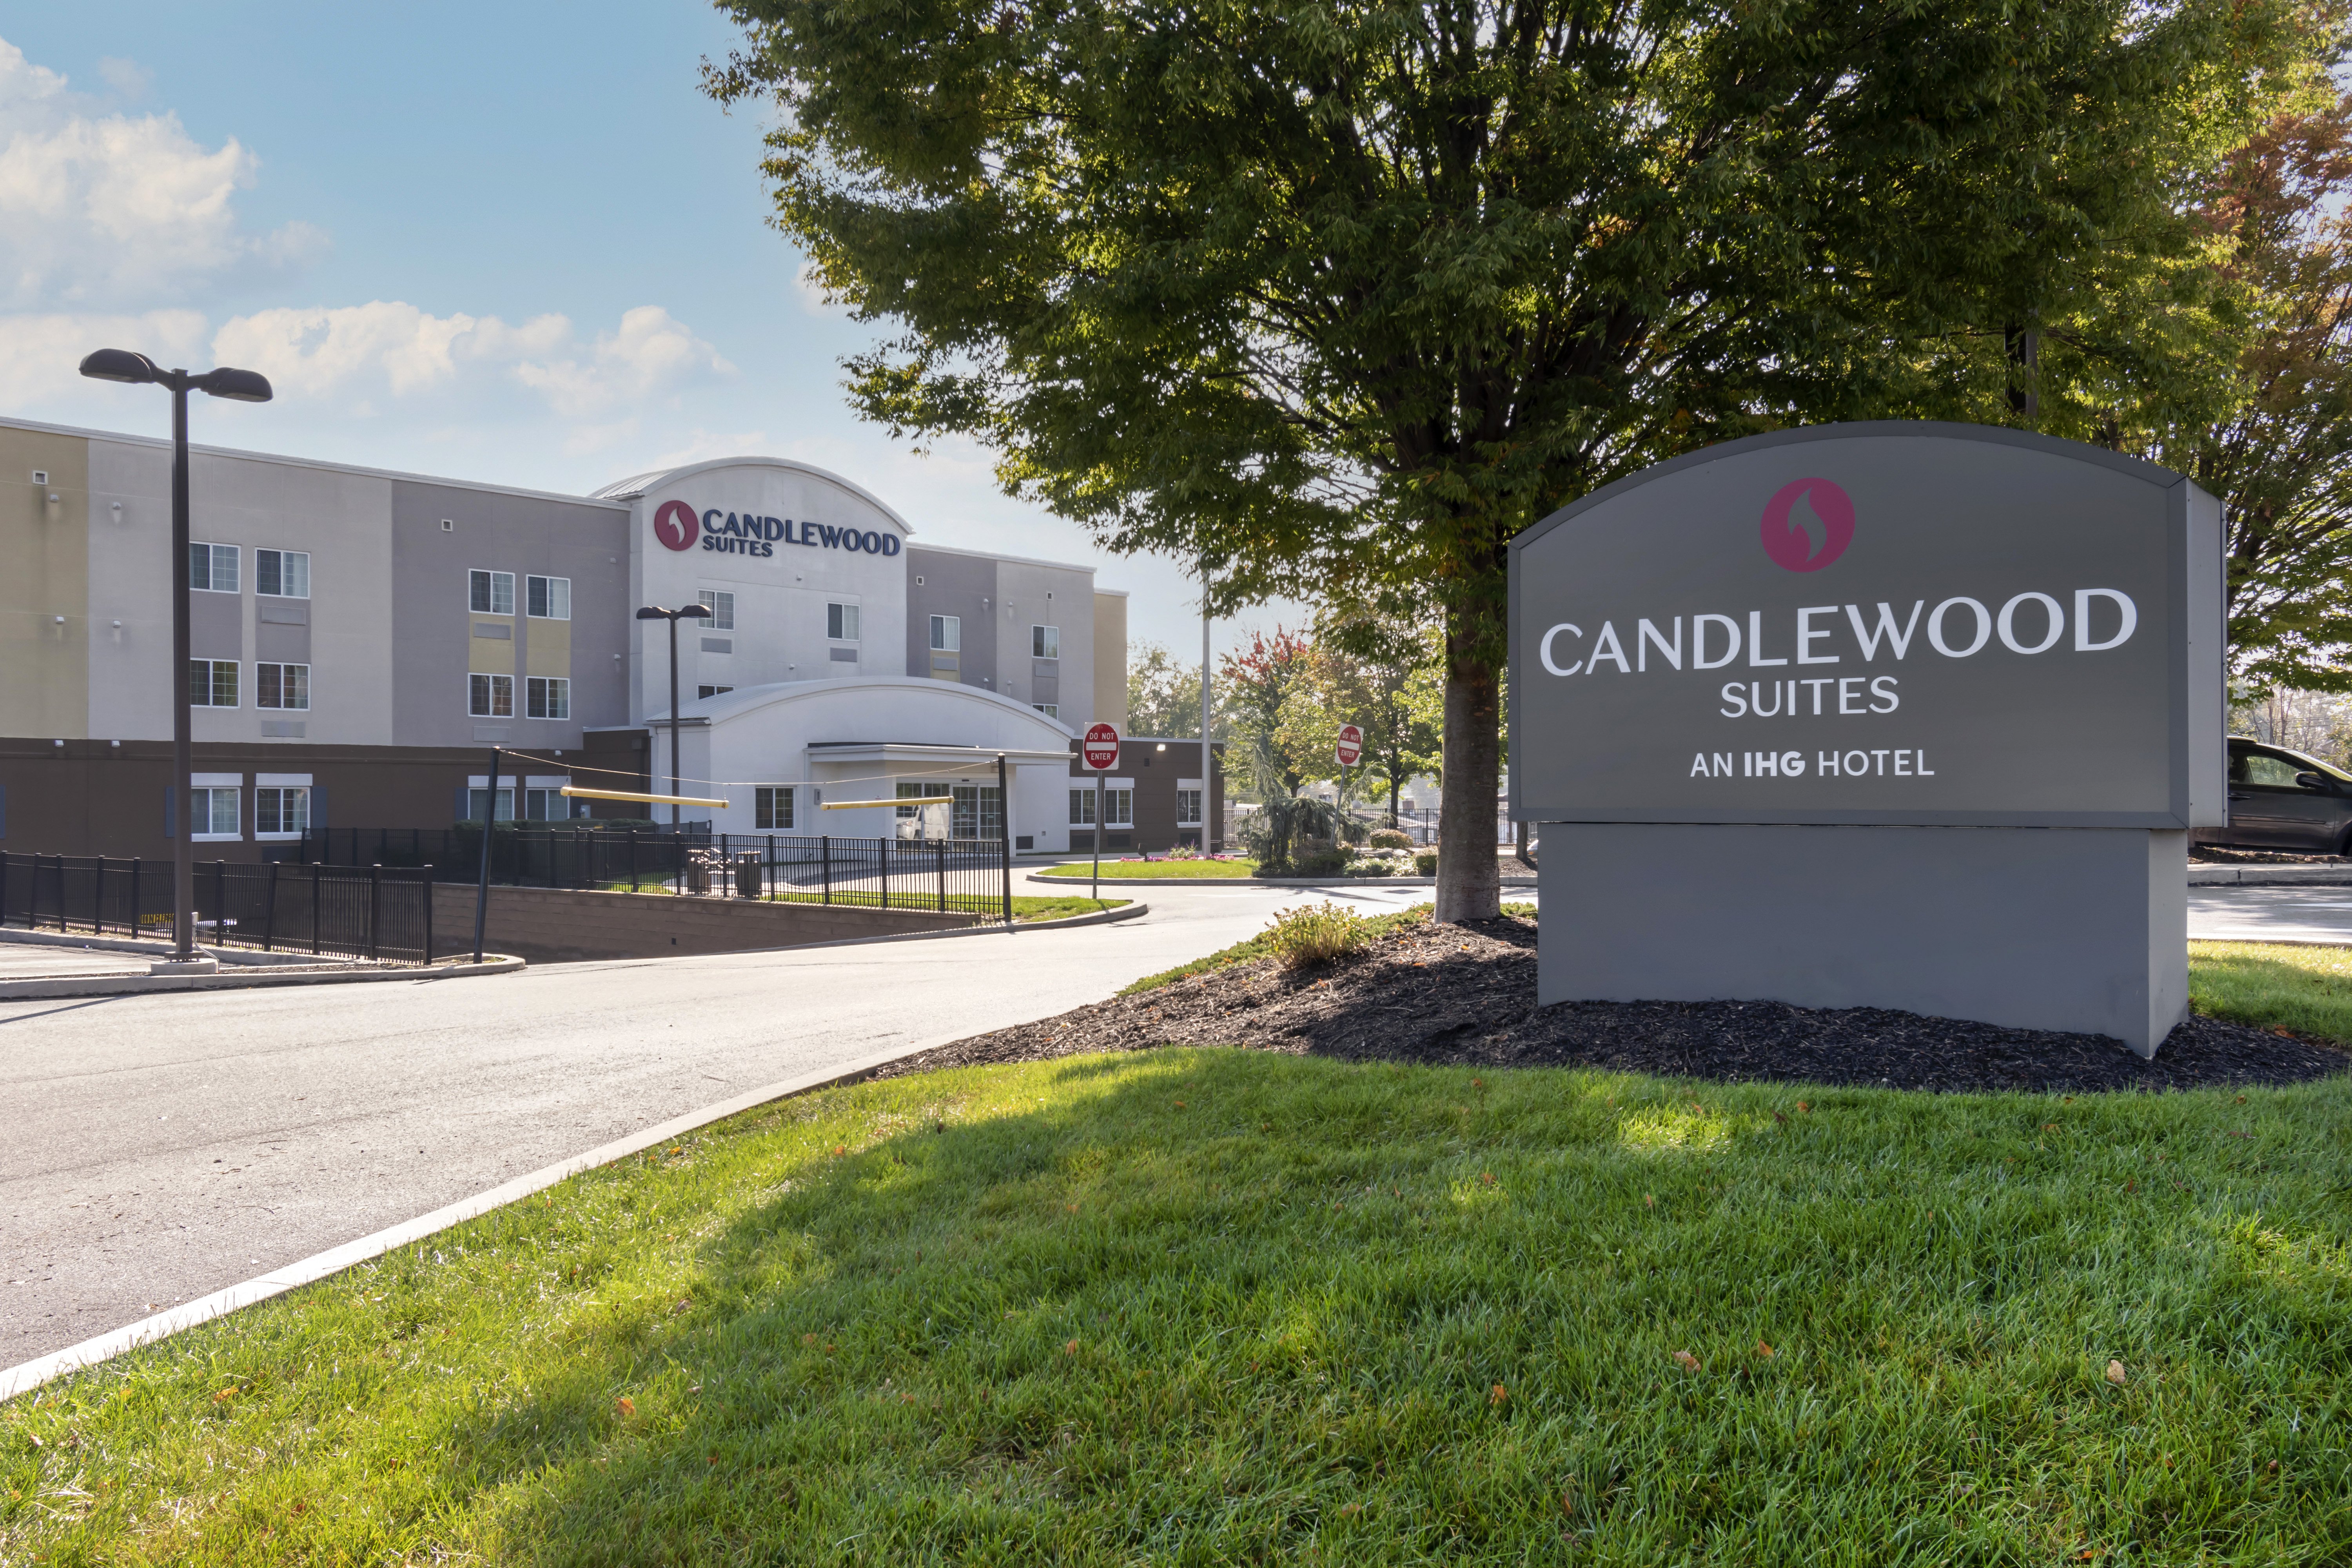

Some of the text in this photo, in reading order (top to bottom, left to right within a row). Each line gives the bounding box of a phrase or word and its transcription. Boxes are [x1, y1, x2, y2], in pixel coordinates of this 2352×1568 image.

[702, 509, 900, 556] CANDLEWOOD
[702, 535, 773, 557] SUITES
[1540, 588, 2137, 676] CANDLEWOOD
[1720, 676, 1899, 718] SUITES
[1341, 750, 1355, 758] ENTER
[1690, 750, 1935, 777] AN IHG HOTEL
